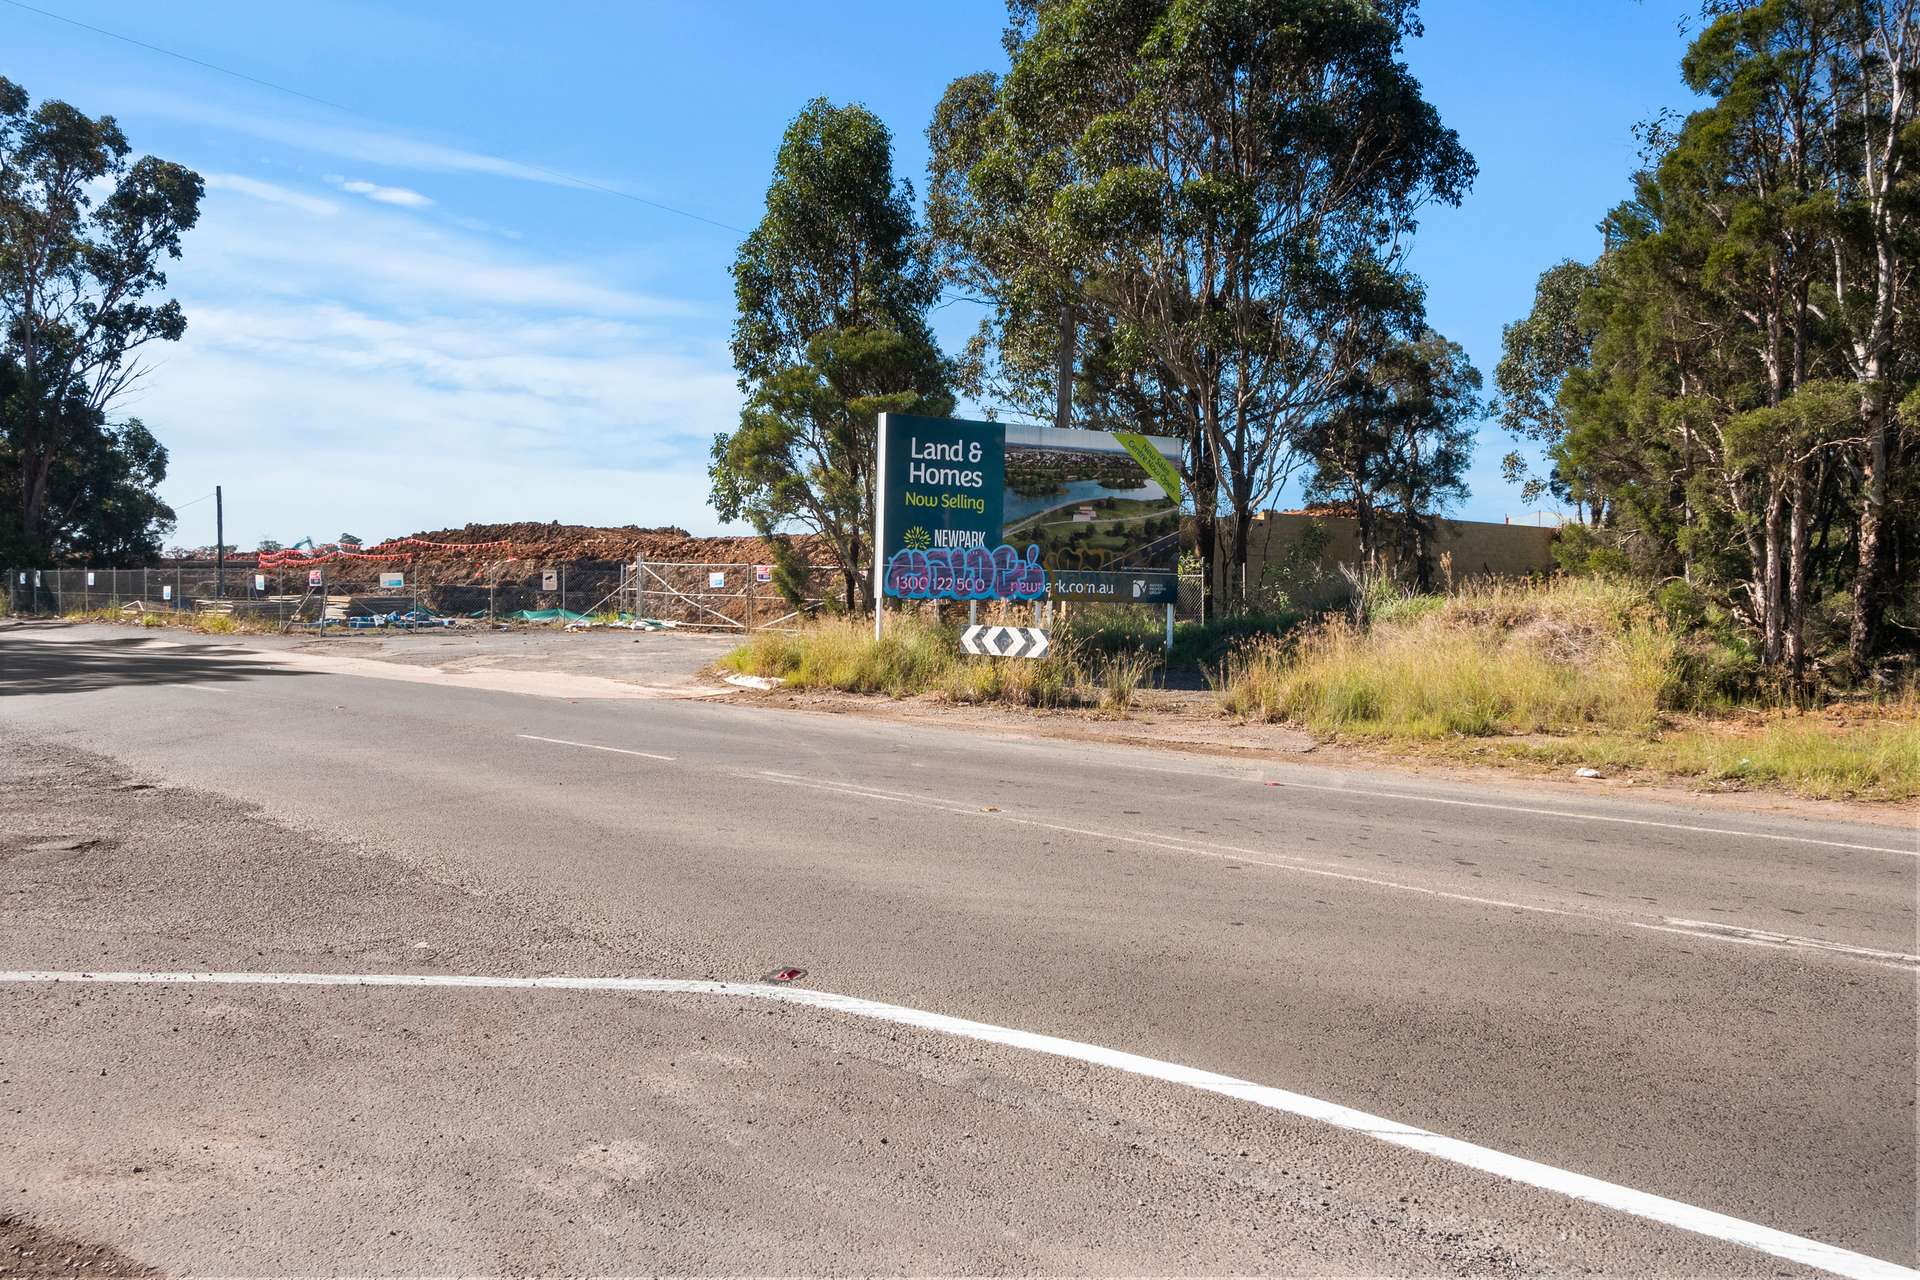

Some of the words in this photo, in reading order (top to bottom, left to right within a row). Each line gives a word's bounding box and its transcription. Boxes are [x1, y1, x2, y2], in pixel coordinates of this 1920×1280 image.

[911, 437, 963, 461] Land
[968, 442, 983, 463] &
[909, 462, 983, 487] Homes
[905, 491, 938, 507] Now
[941, 494, 985, 514] Selling
[934, 529, 986, 548] NEWPARK
[896, 577, 928, 590] 1300
[933, 577, 953, 591] 122
[957, 579, 985, 592] 500
